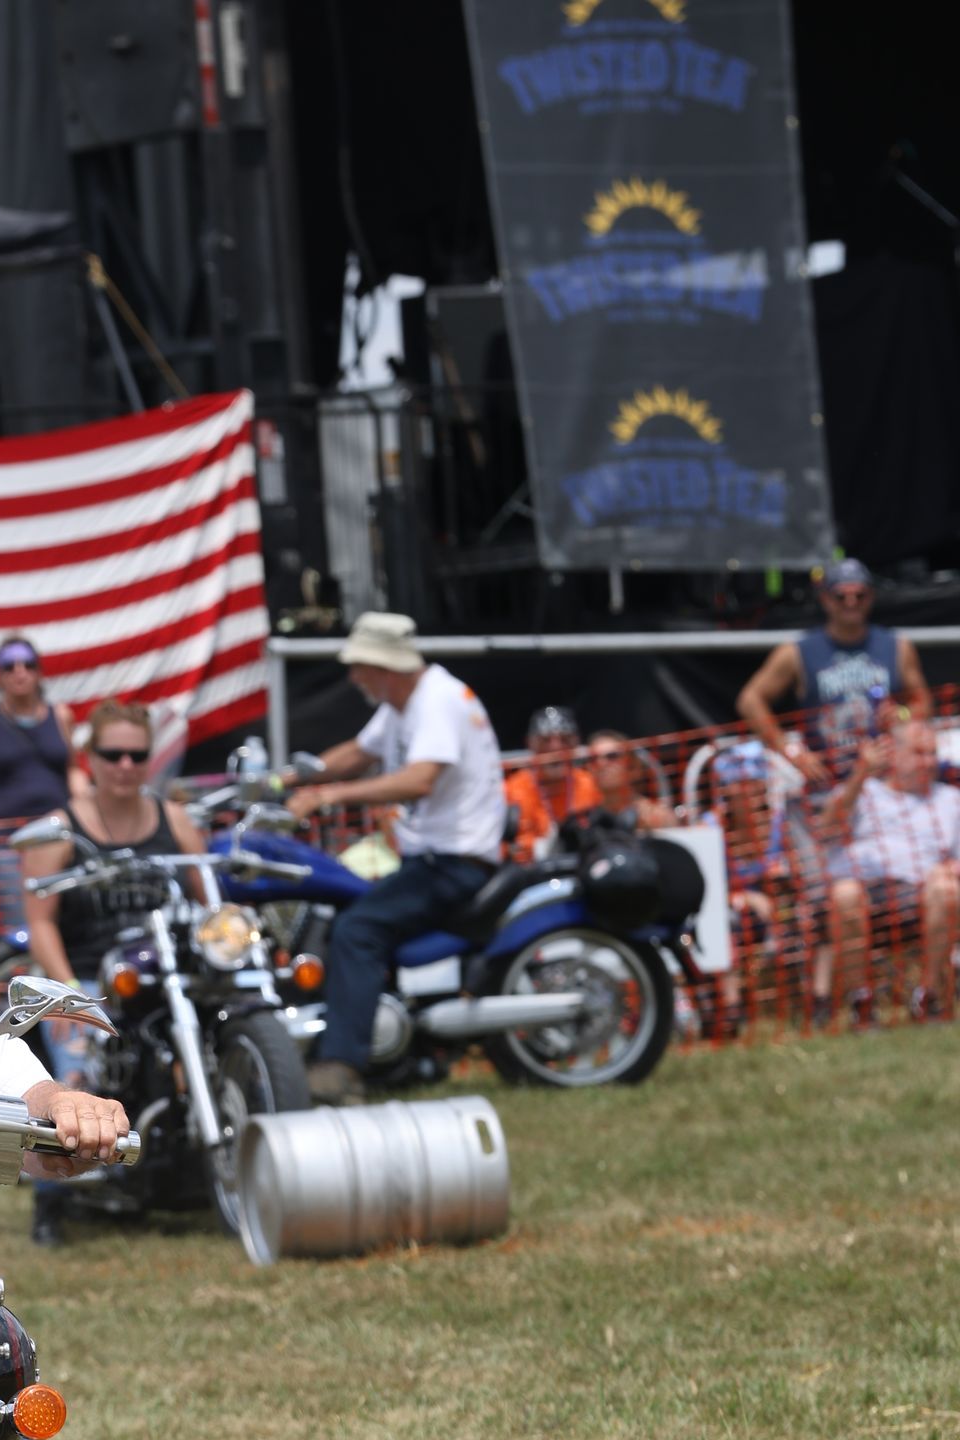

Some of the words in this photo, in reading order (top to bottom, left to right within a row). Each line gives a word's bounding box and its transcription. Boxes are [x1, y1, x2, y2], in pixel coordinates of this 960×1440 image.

[498, 40, 669, 115] TWISTED
[671, 38, 750, 111] TEA
[527, 251, 684, 323] TWISTED
[559, 457, 709, 527] TWISTED
[711, 456, 786, 528] TEA
